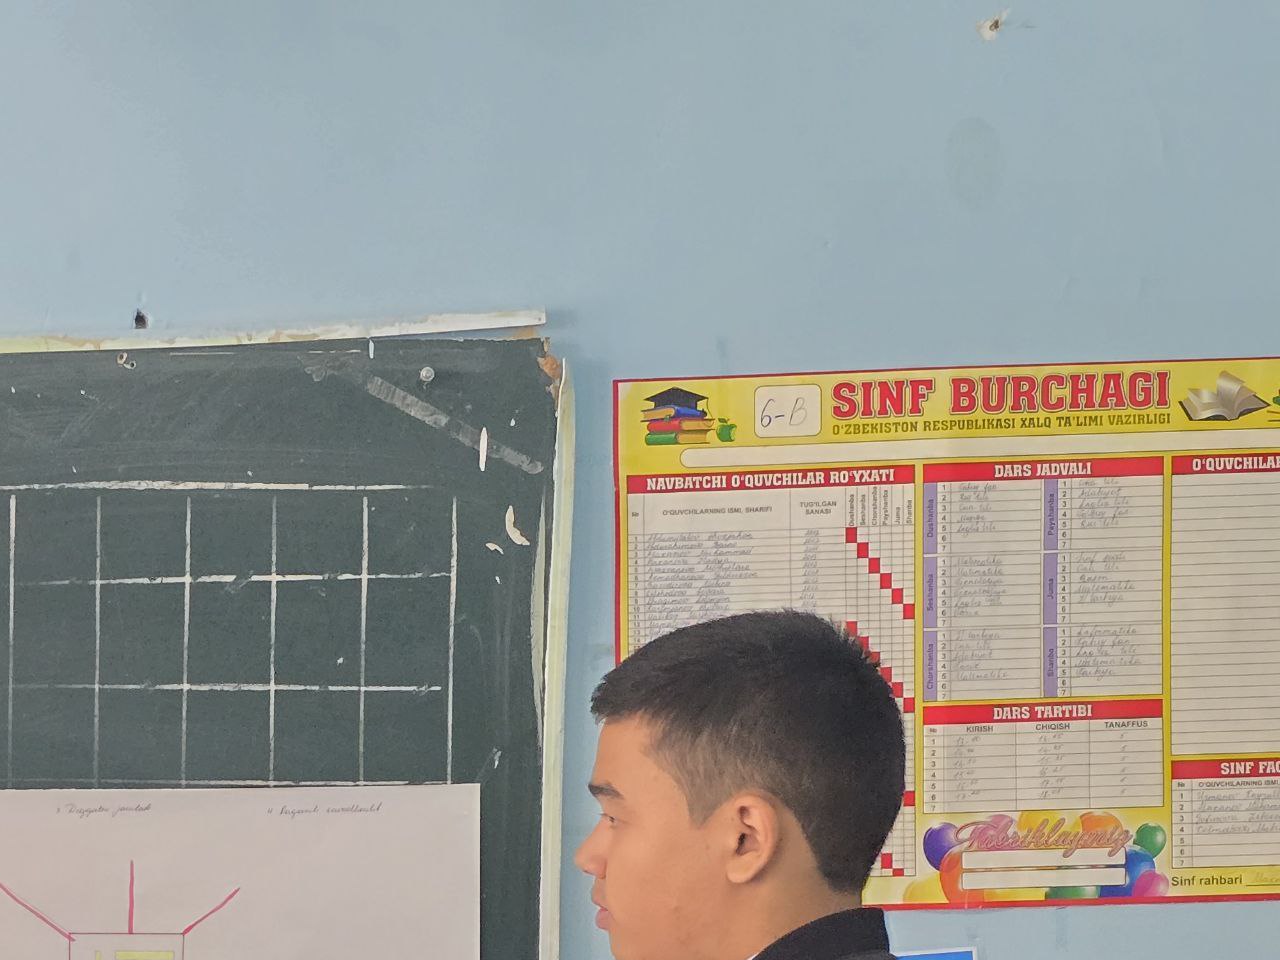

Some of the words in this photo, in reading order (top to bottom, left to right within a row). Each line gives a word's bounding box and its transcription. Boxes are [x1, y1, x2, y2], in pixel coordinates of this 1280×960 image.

[831, 378, 935, 420] SINF
[949, 370, 1170, 416] BURCHAGI
[923, 417, 1016, 432] RESPUBLIKASI
[1020, 417, 1051, 430] XALQ
[1108, 413, 1170, 425] VAZIRLIGI
[994, 464, 1031, 477] DARS
[1036, 461, 1091, 476] JADVALI
[646, 475, 726, 491] NAVBATCHI
[1048, 493, 1056, 536] Payshanba
[993, 707, 1030, 719] DARS
[1035, 704, 1092, 718] TARTIBI
[1104, 720, 1149, 728] TANAFFUS
[1220, 762, 1254, 775] SINF
[1171, 876, 1196, 887] Sinf
[1200, 874, 1243, 886] rahbari
